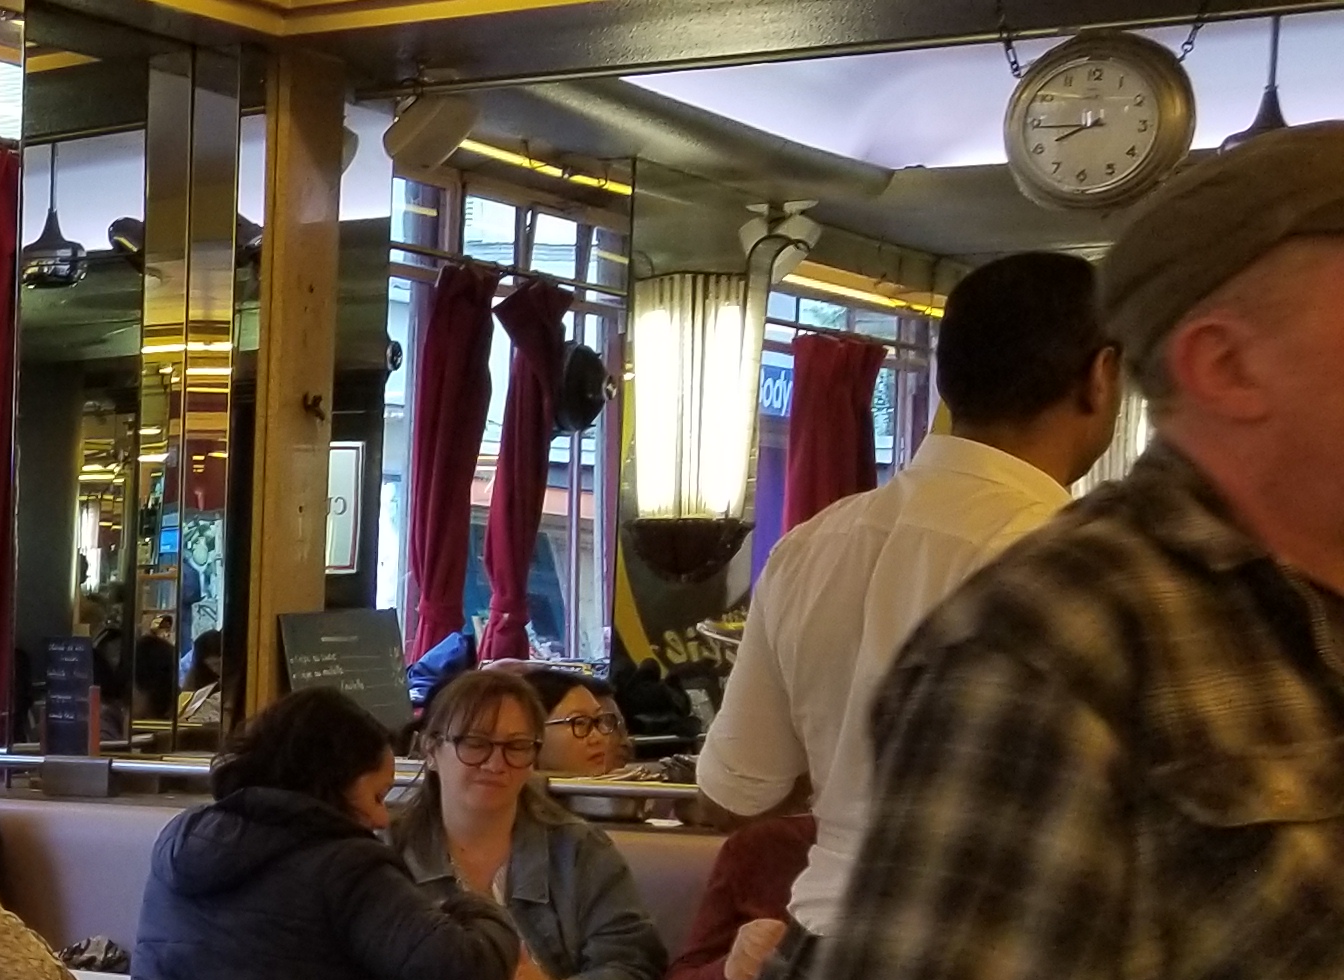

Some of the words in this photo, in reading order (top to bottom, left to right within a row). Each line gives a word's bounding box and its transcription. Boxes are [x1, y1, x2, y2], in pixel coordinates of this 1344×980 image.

[1087, 68, 1103, 82] 12
[1137, 120, 1148, 133] 3
[1126, 145, 1137, 158] 4
[1052, 162, 1062, 175] 7
